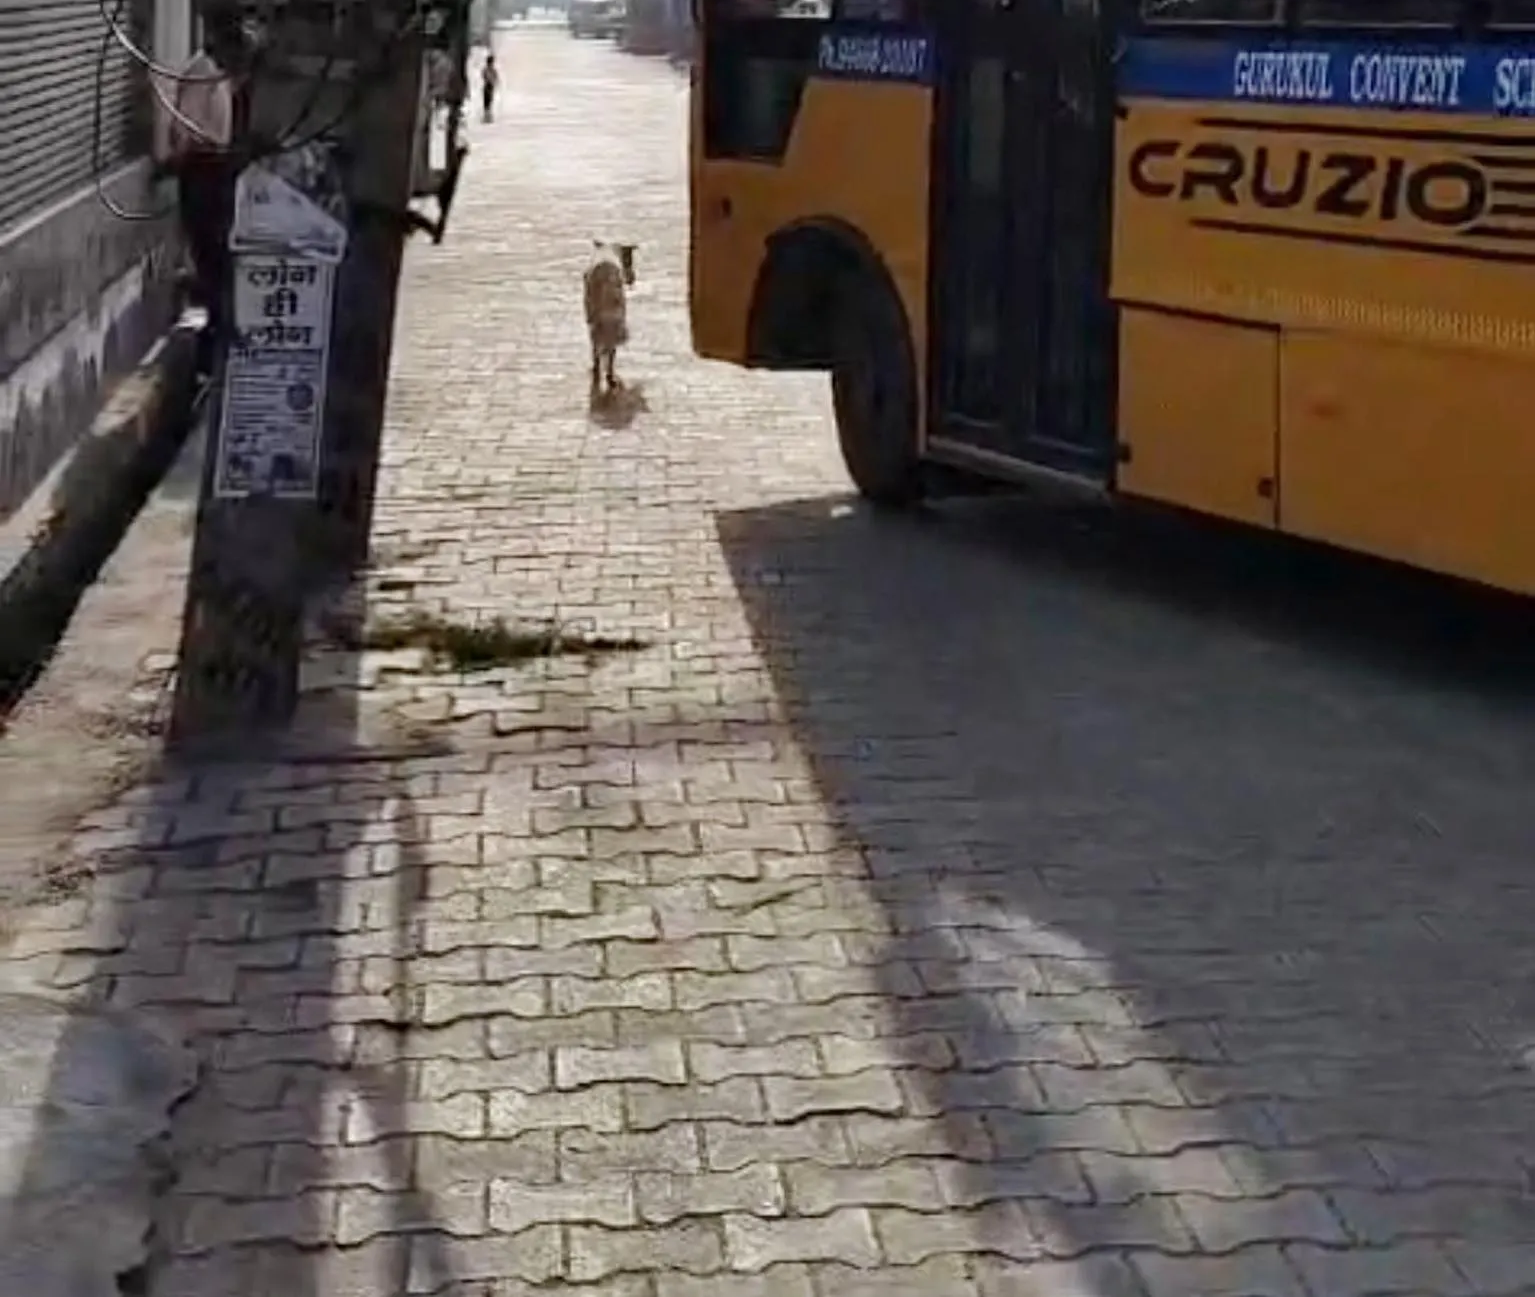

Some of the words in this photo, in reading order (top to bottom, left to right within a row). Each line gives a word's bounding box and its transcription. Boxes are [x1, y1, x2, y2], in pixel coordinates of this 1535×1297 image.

[1234, 52, 1334, 98] GURUKUL
[1350, 55, 1465, 105] CONVENT
[1129, 140, 1488, 226] CRUZIO
